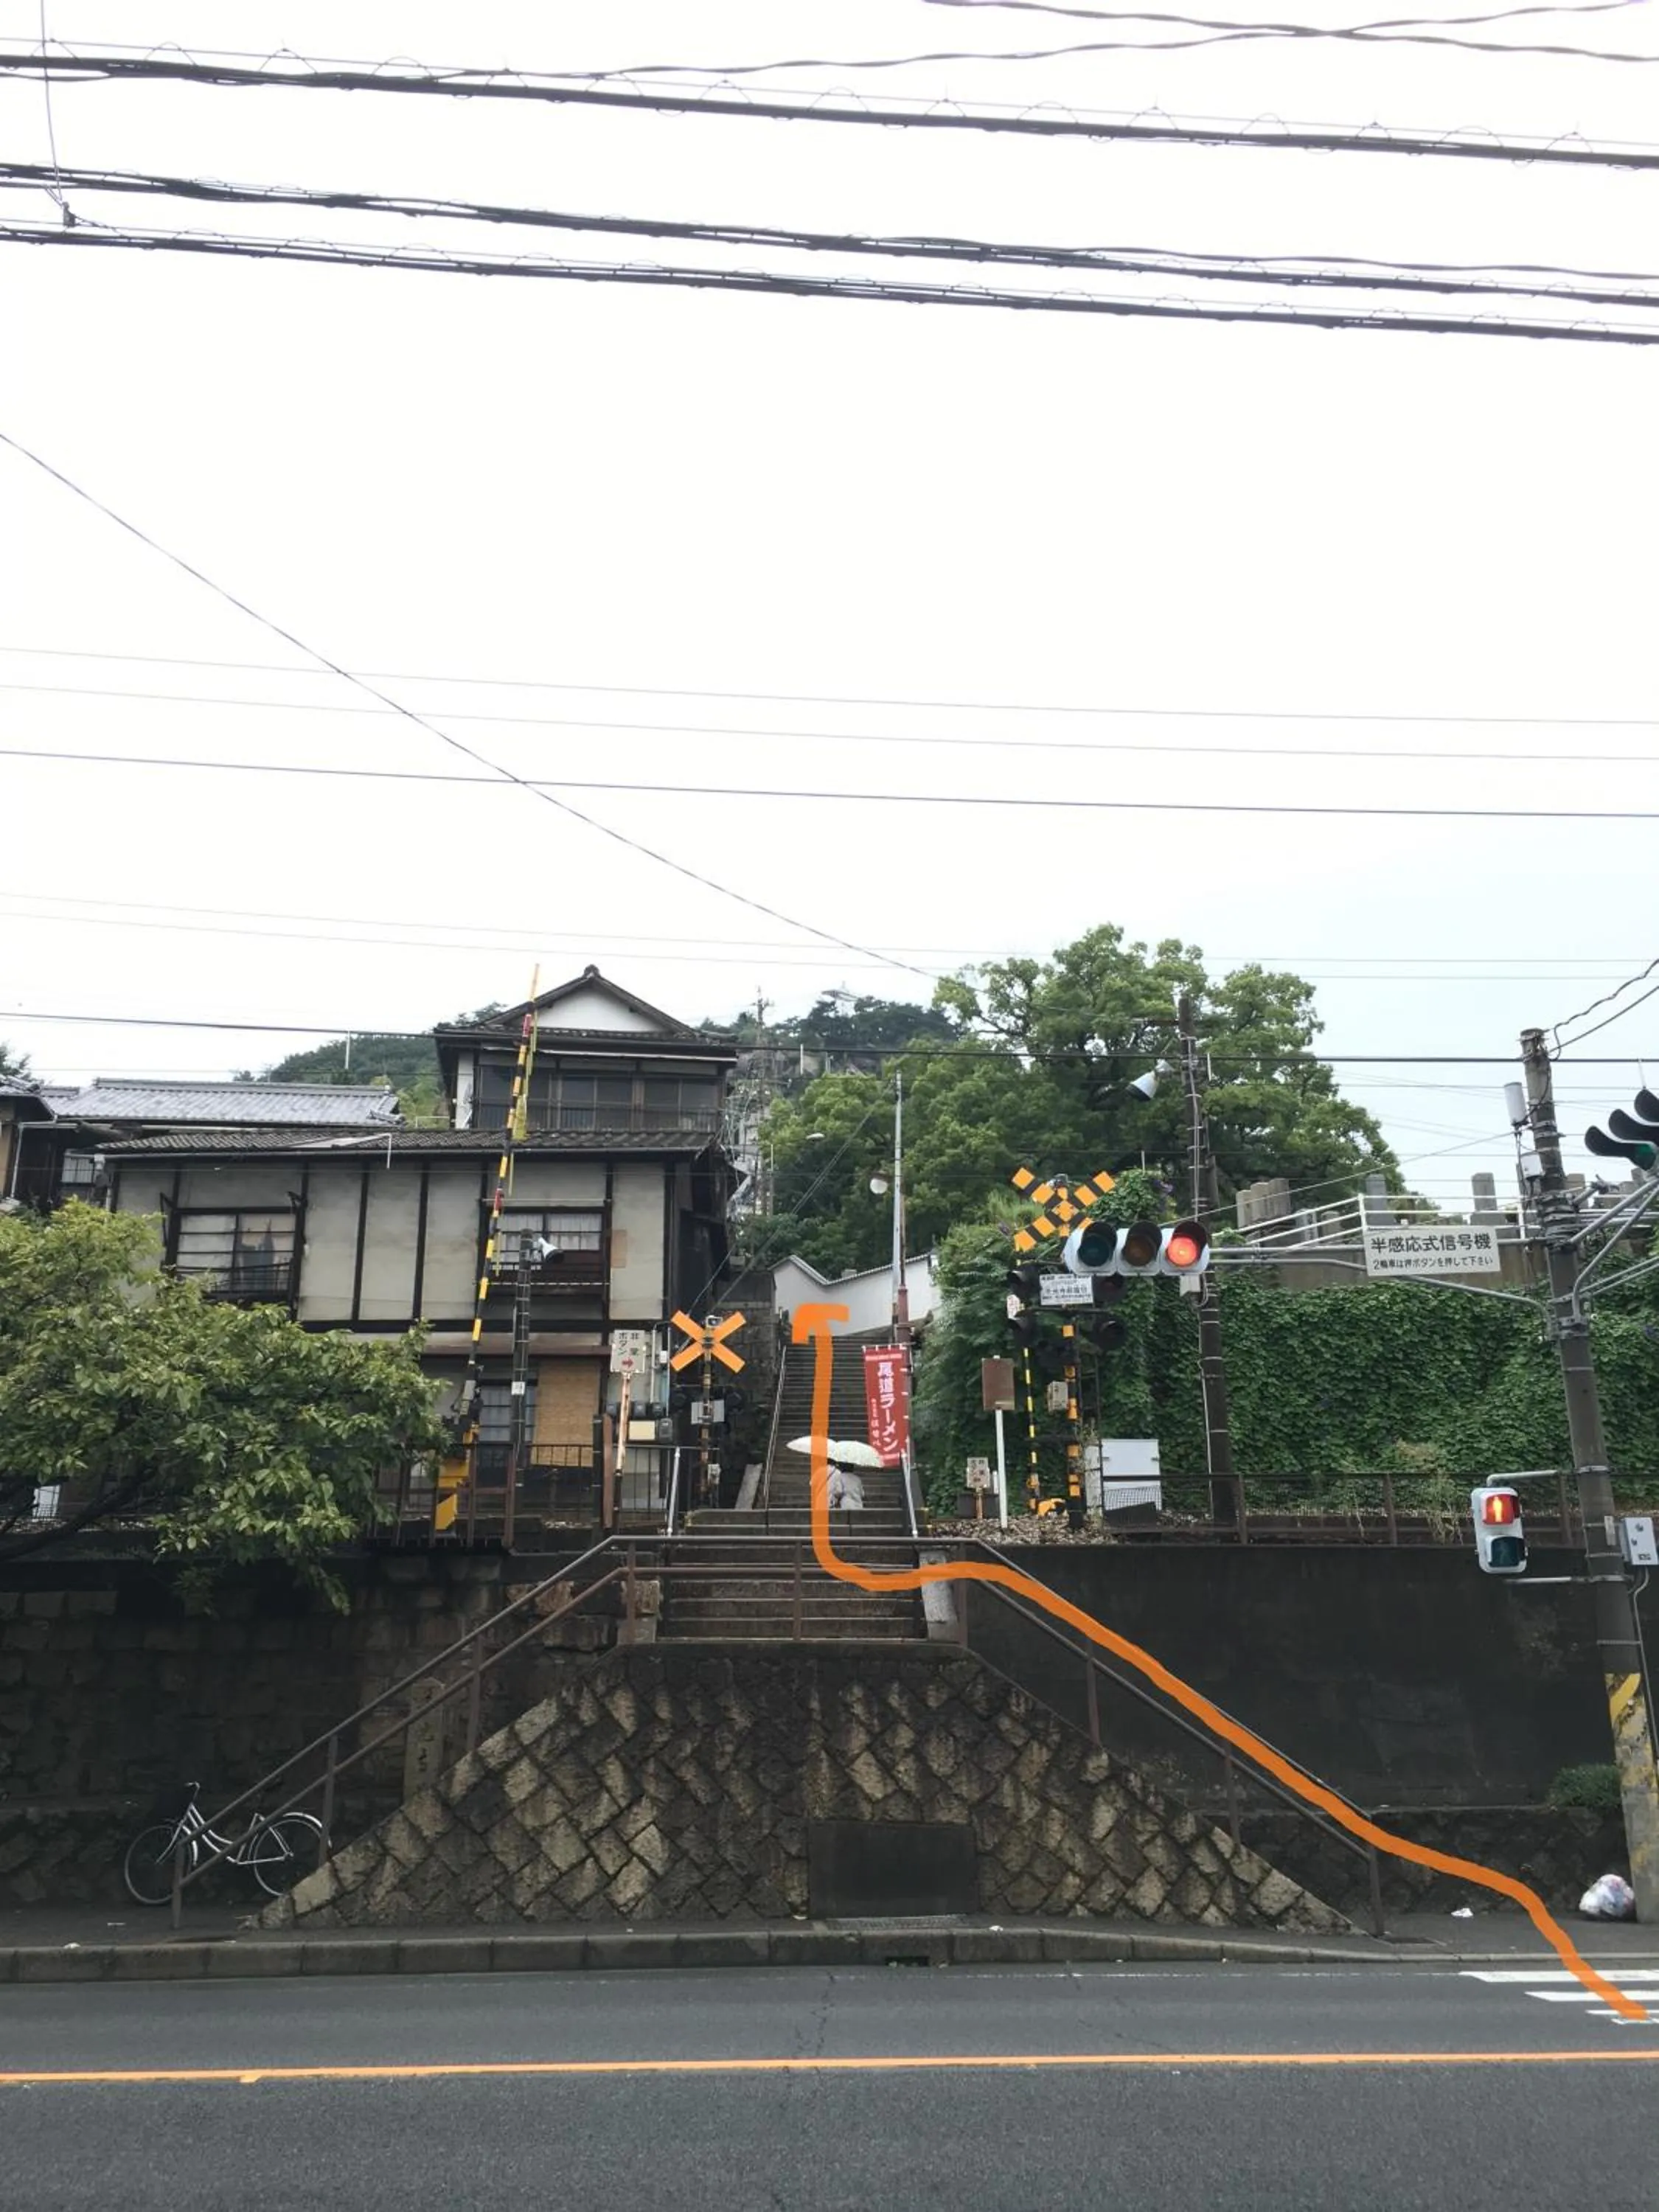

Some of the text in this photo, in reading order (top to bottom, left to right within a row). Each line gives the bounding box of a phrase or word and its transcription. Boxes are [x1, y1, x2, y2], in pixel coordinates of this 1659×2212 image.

[1371, 1232, 1492, 1253] 半感応式信号機
[877, 1361, 899, 1452] 尾道ラーメン
